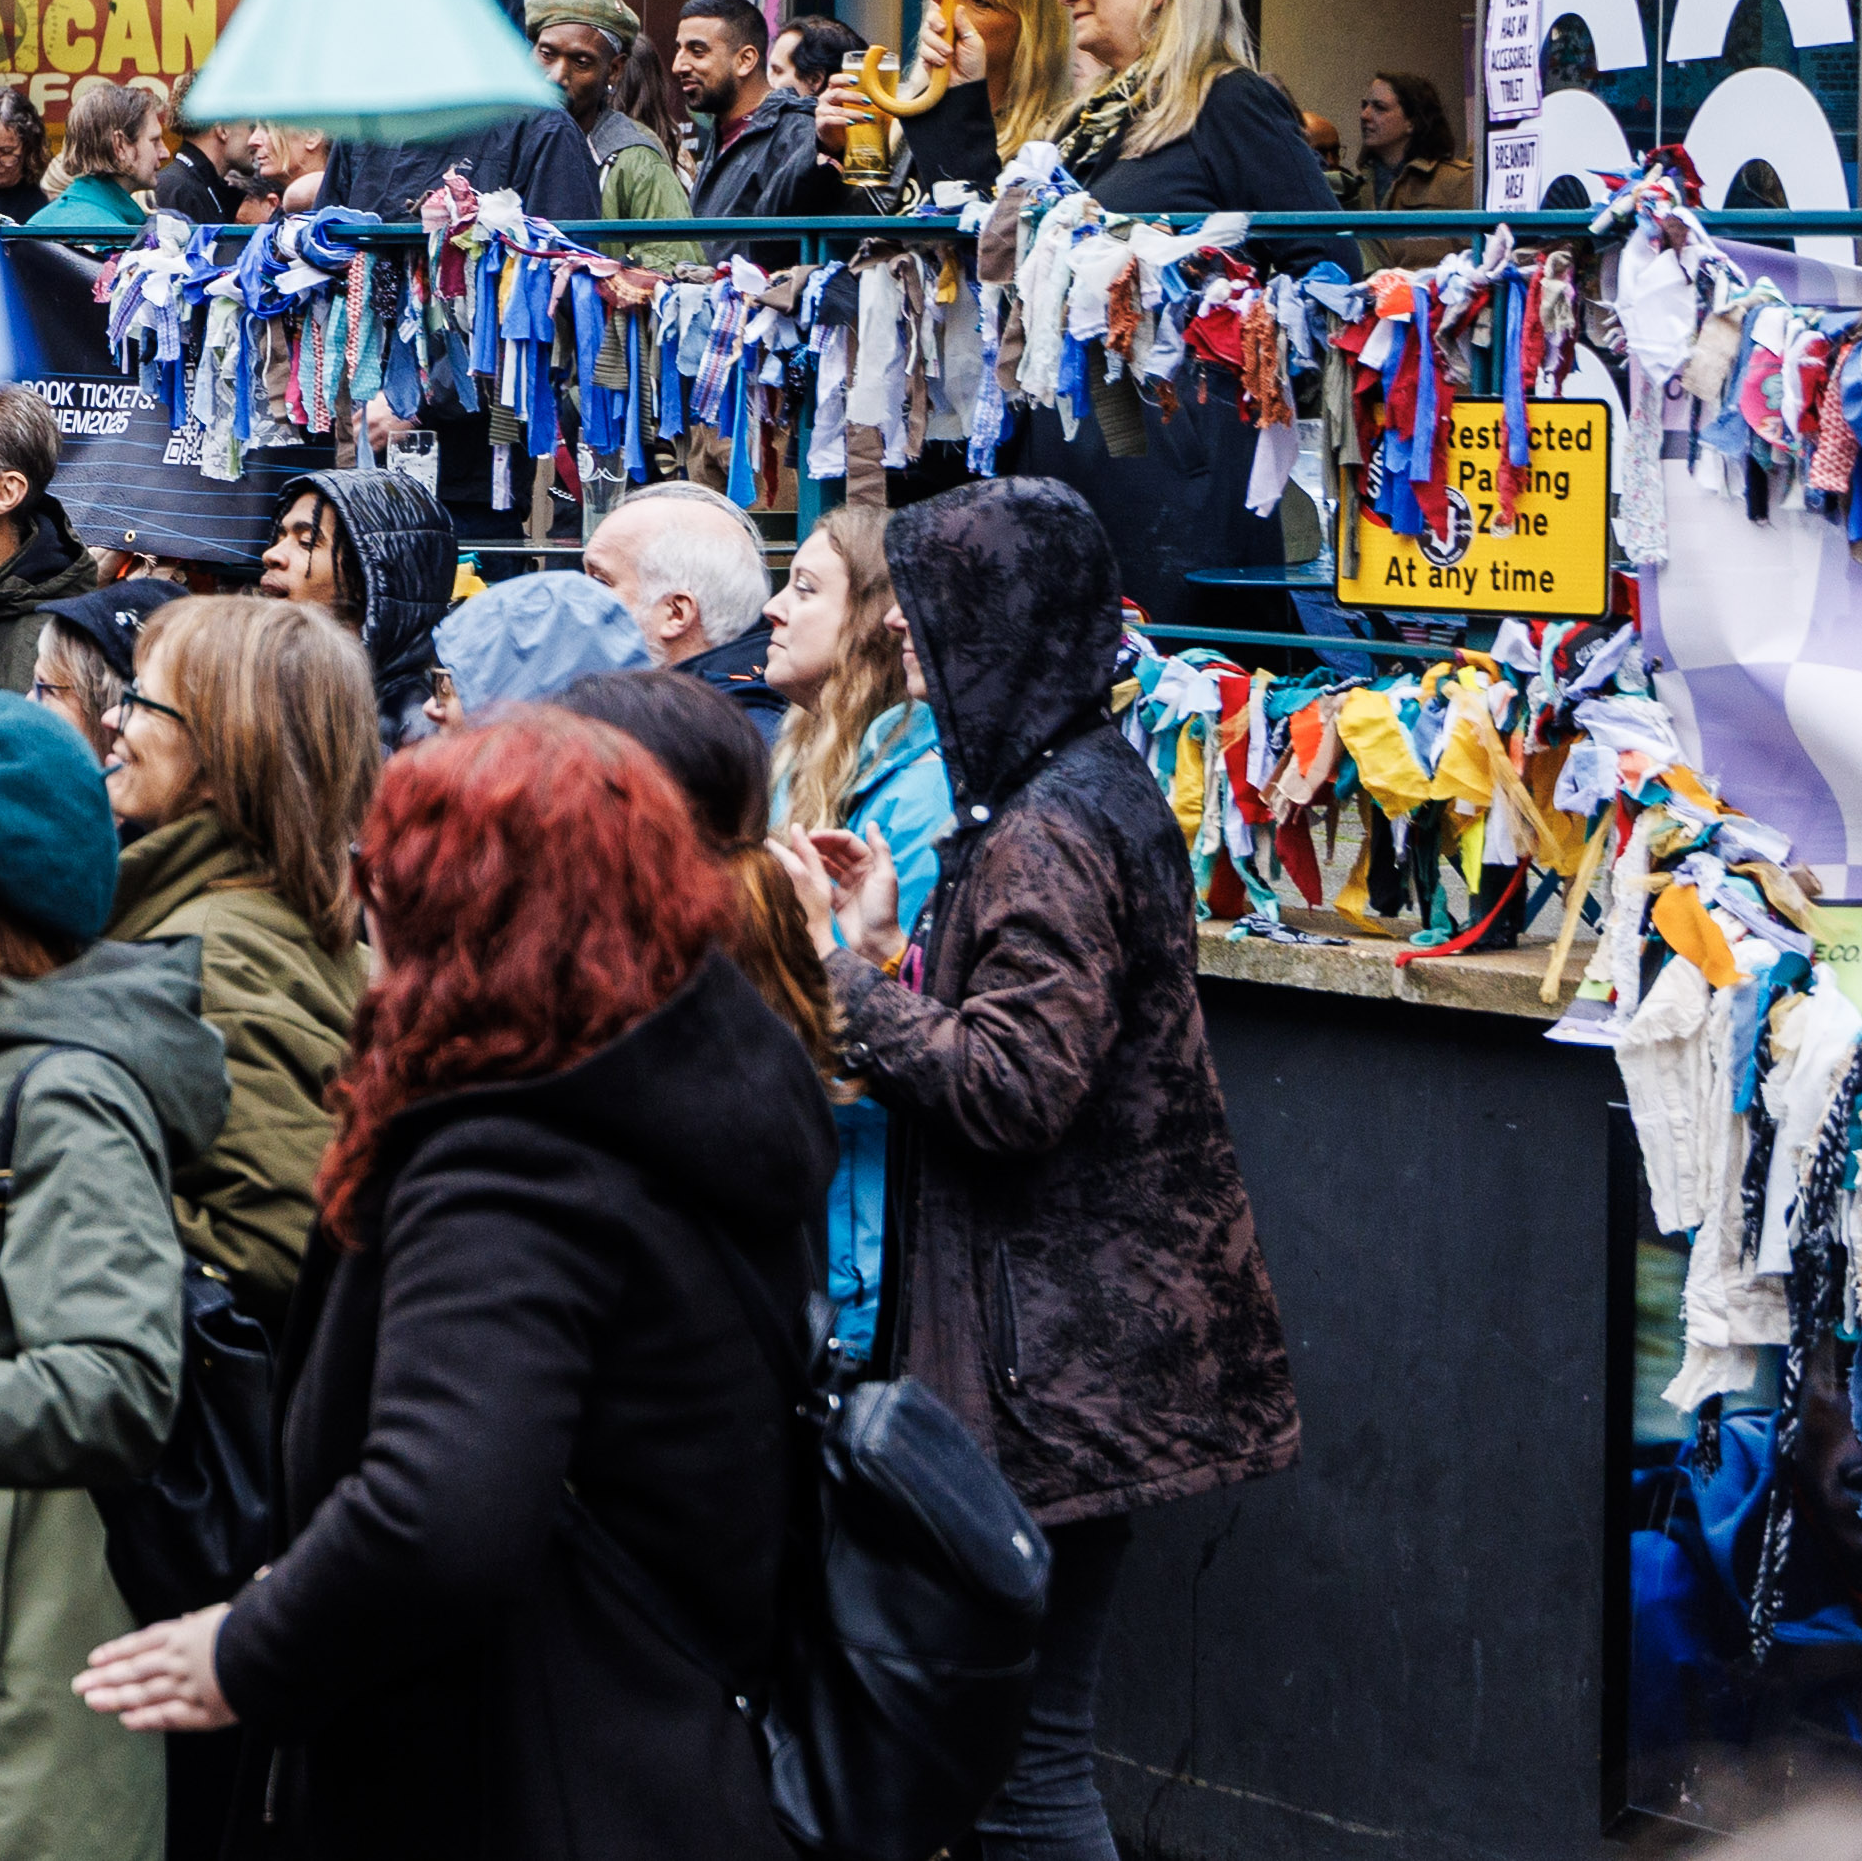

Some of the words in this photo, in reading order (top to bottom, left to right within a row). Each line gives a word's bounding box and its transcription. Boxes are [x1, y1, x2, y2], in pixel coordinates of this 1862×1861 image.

[1500, 17, 1516, 40] HAS
[1490, 44, 1533, 72] ACCESSIBLE
[1500, 78, 1524, 103] TOILET
[1495, 142, 1536, 170] BREAKOUT
[1504, 174, 1525, 199] AREA
[1448, 419, 1593, 452] estcted
[1459, 460, 1570, 500] Paing
[1478, 504, 1549, 537] Zne
[1385, 556, 1418, 589] At
[1428, 566, 1479, 596] any
[1490, 560, 1555, 594] time
